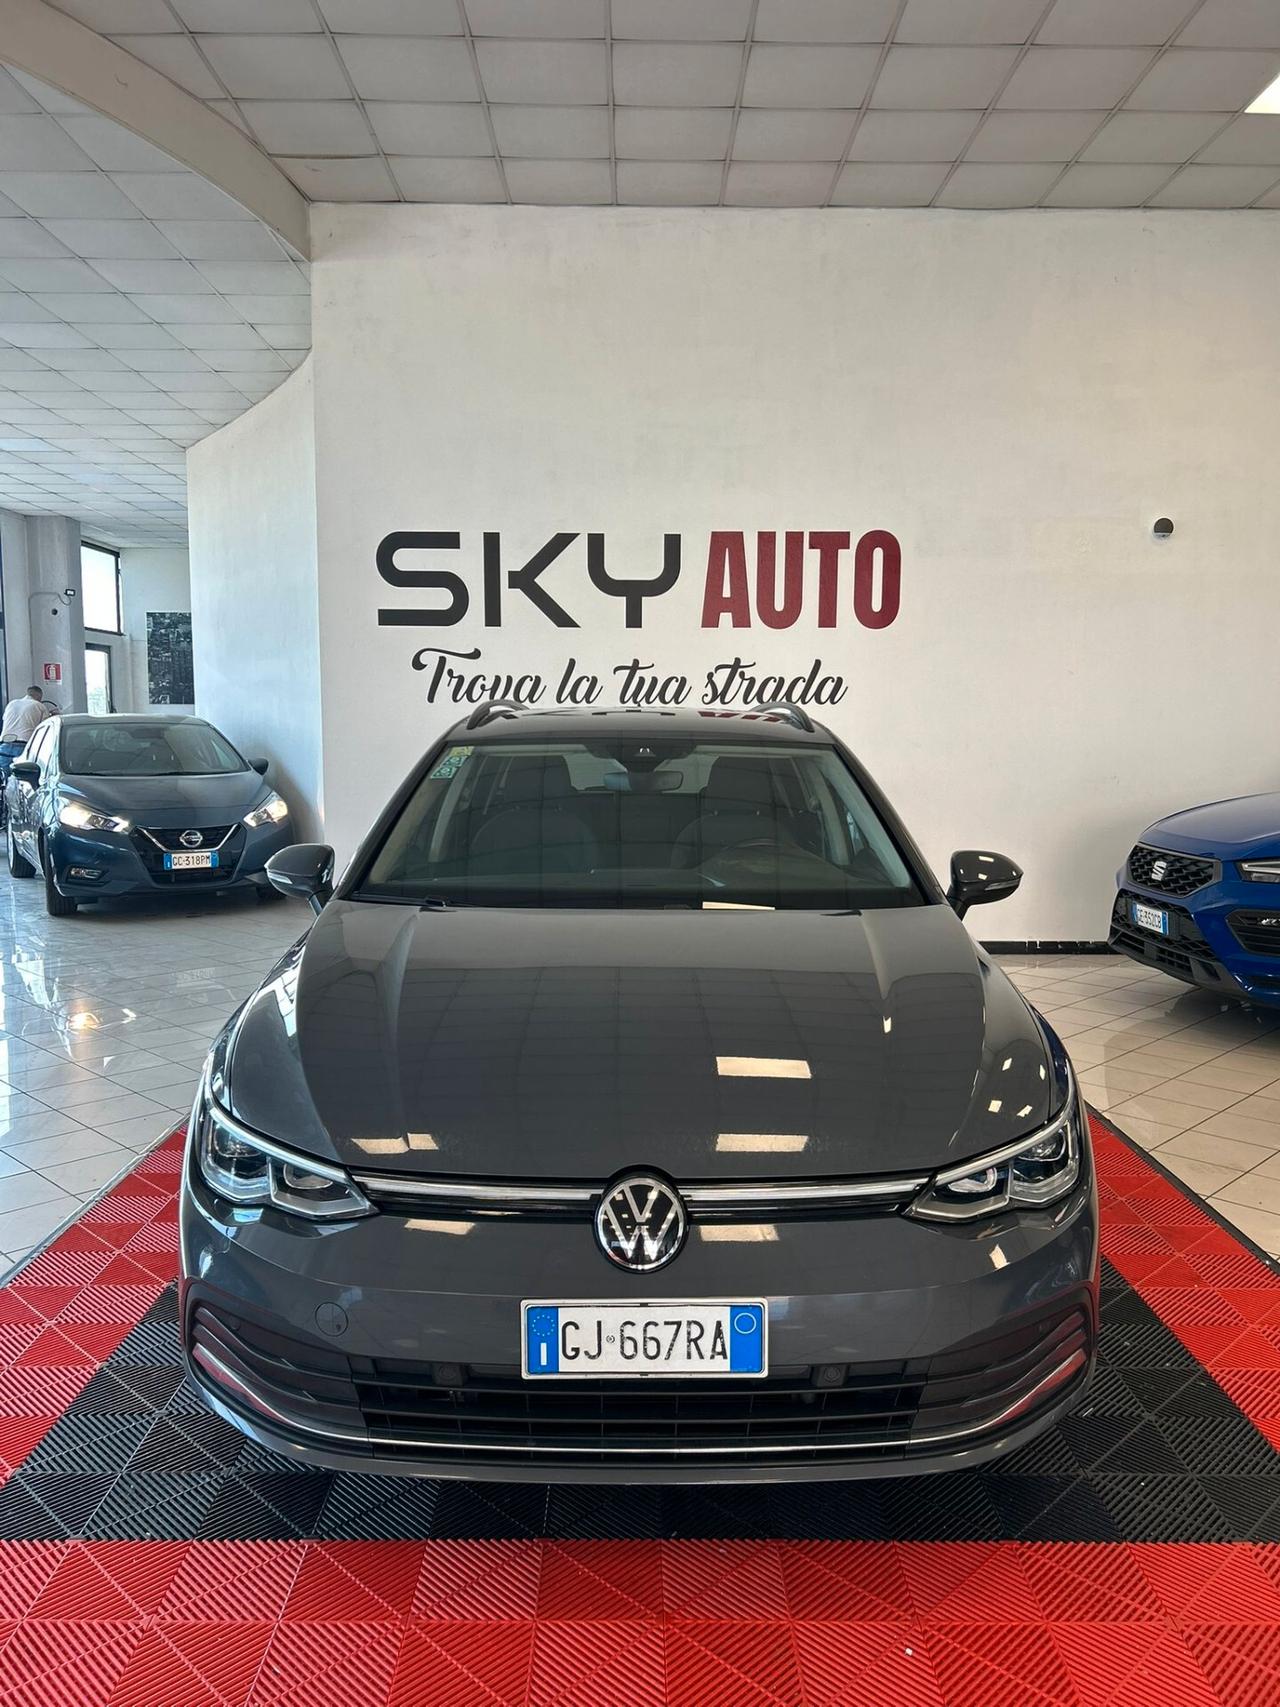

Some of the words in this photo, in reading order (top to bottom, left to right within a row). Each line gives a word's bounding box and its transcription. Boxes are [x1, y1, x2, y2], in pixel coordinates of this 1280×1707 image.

[376, 531, 682, 629] SKY
[701, 530, 902, 630] AUTO
[411, 647, 547, 704] Trova
[555, 657, 604, 705] la
[613, 658, 693, 705] tua
[701, 656, 849, 705] strada
